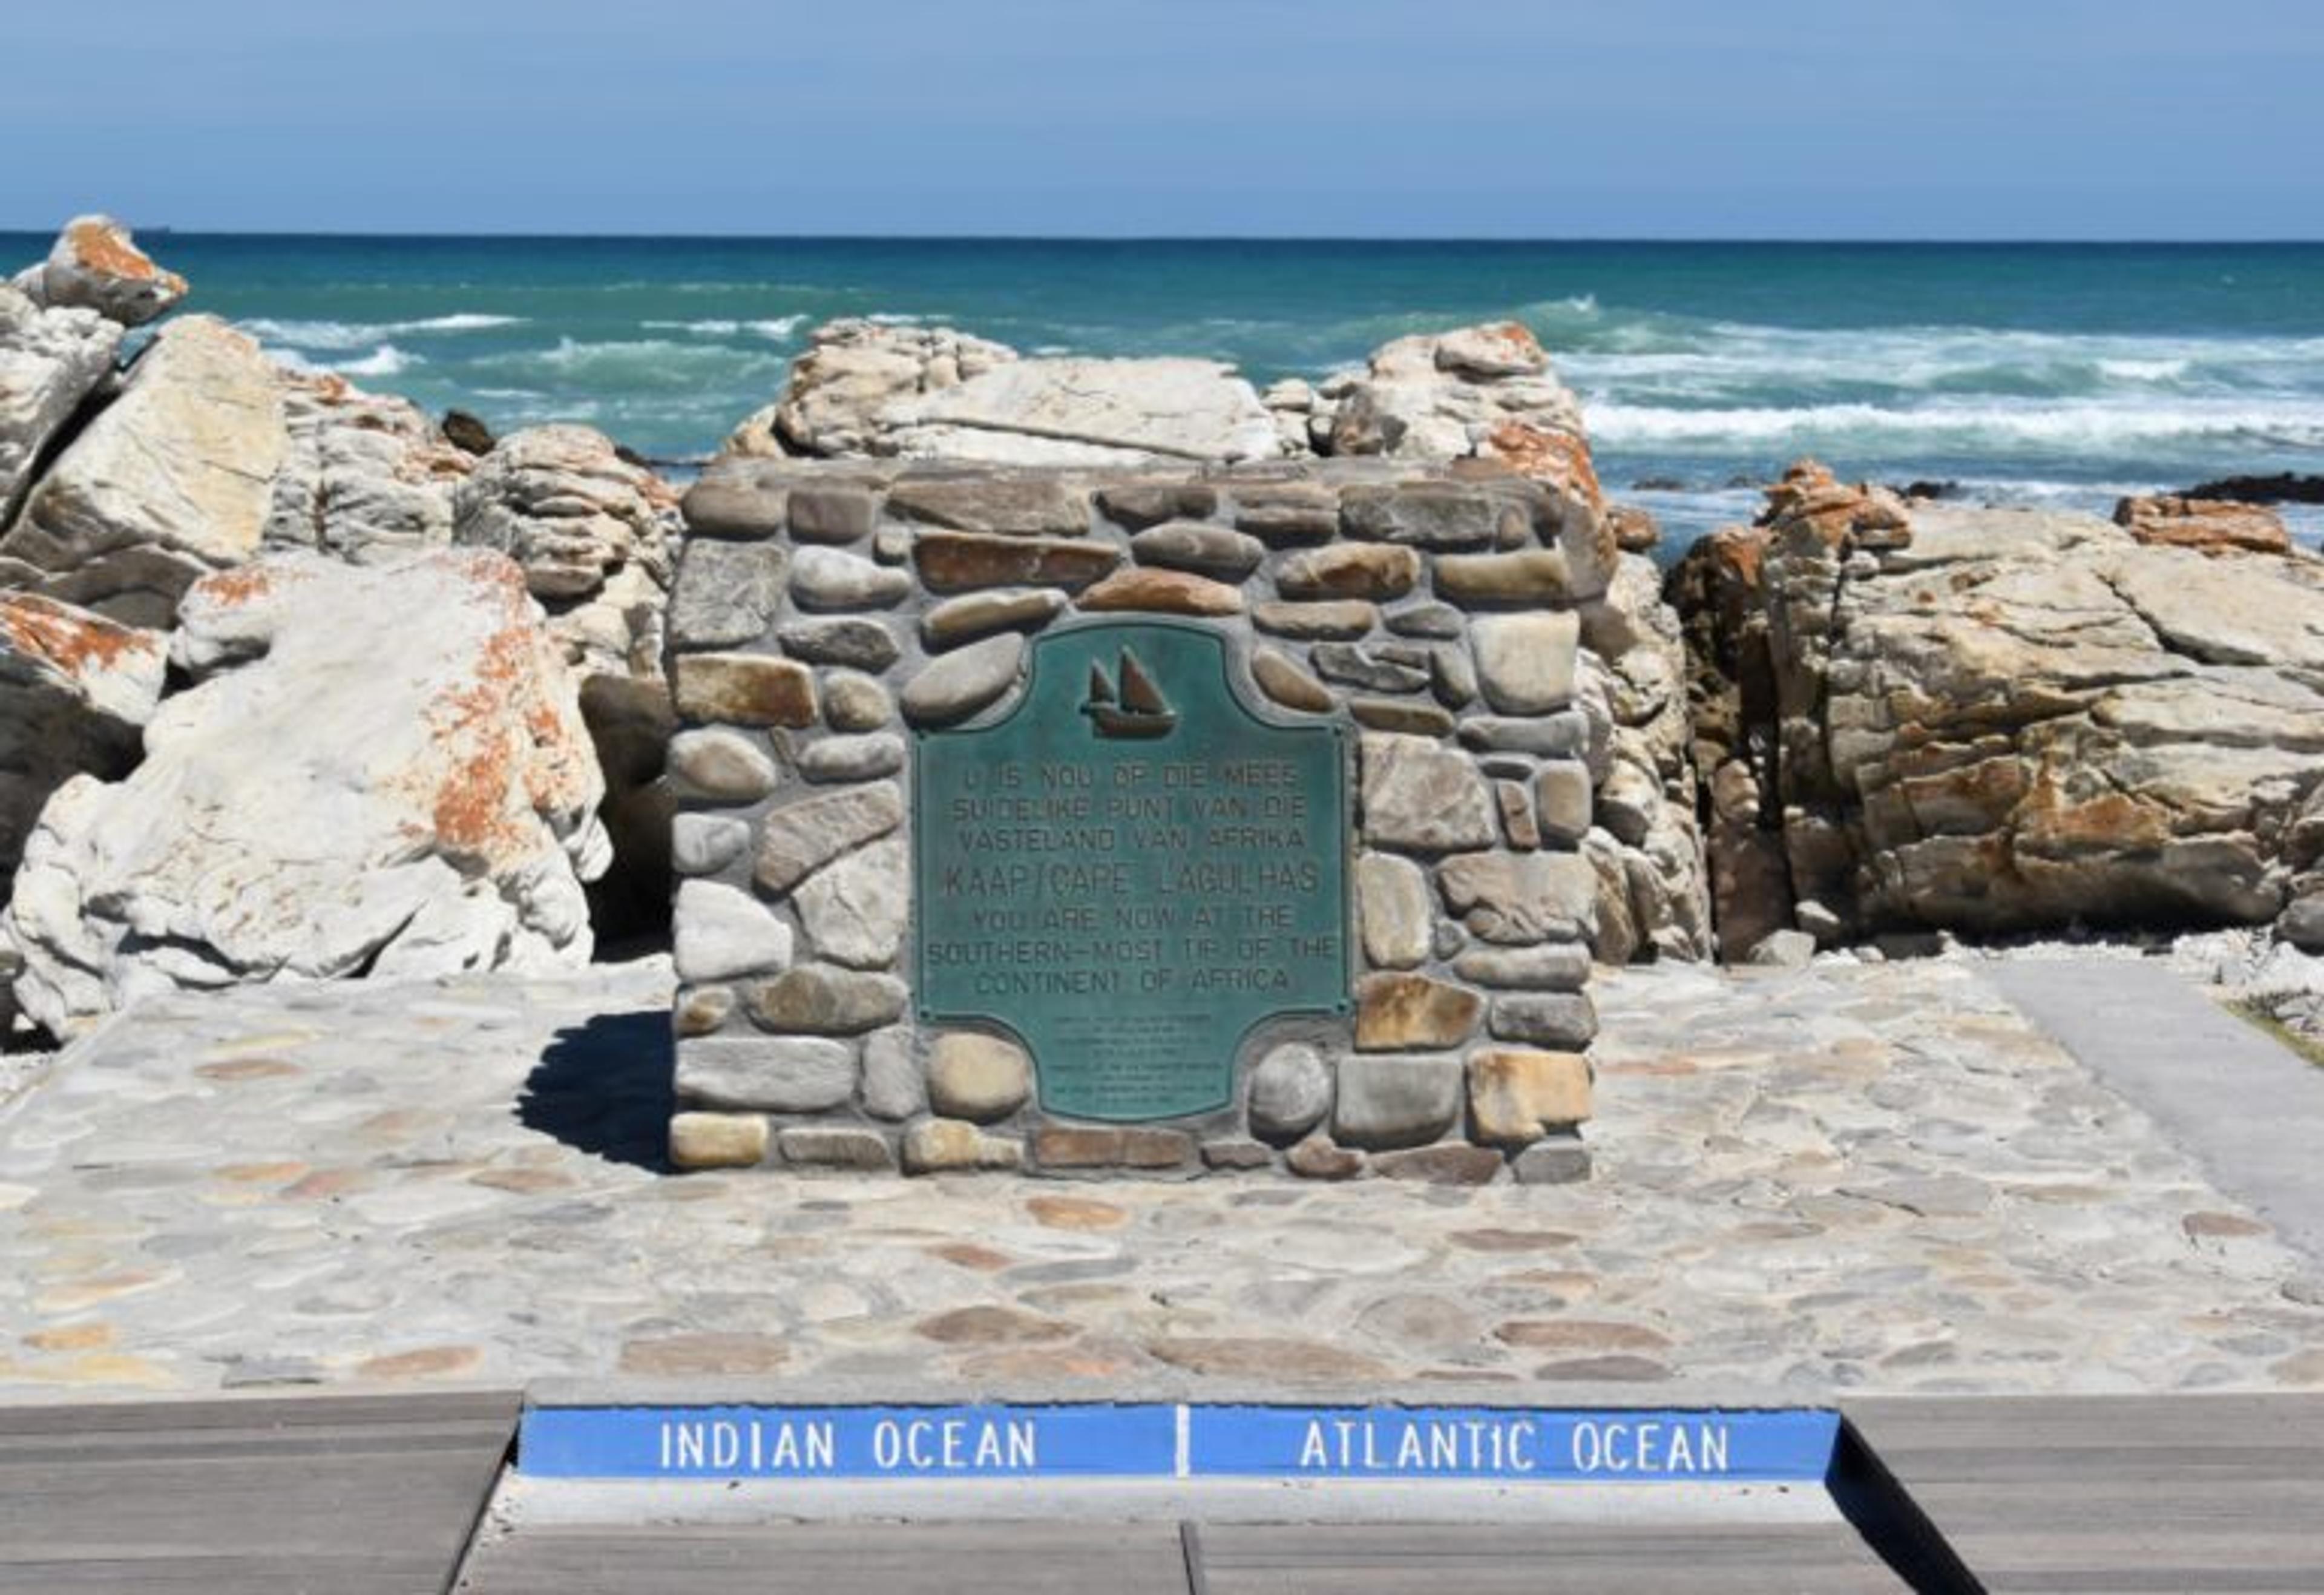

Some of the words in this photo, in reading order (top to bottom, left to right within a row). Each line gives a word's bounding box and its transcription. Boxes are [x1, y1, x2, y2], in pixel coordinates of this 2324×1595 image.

[998, 763, 1019, 788] IS
[1041, 764, 1092, 789] NOU
[1163, 763, 1206, 789] DIE
[1107, 797, 1173, 822] PUNT
[1194, 795, 1248, 820] VAN
[1264, 795, 1307, 819] DIE
[958, 827, 1115, 852] VASTELAND
[1134, 827, 1187, 849] VAN
[1209, 826, 1305, 849] AFRIKA
[973, 908, 1025, 932] YOU
[1044, 907, 1098, 931] ARE
[1115, 907, 1177, 930] NOW
[1193, 906, 1223, 929] AT
[1244, 905, 1294, 928] THE
[1183, 938, 1218, 962] TIP
[1236, 938, 1270, 961] OF
[1290, 936, 1336, 960] THE
[976, 969, 1120, 995] CONTINENT
[1141, 969, 1172, 993] OF
[1192, 967, 1289, 991] AFRICA
[661, 1421, 835, 1469] INDIAN
[872, 1421, 1036, 1468] OCEAN
[1300, 1421, 1536, 1470] ATLANTIC
[1572, 1421, 1729, 1471] OCEAN
